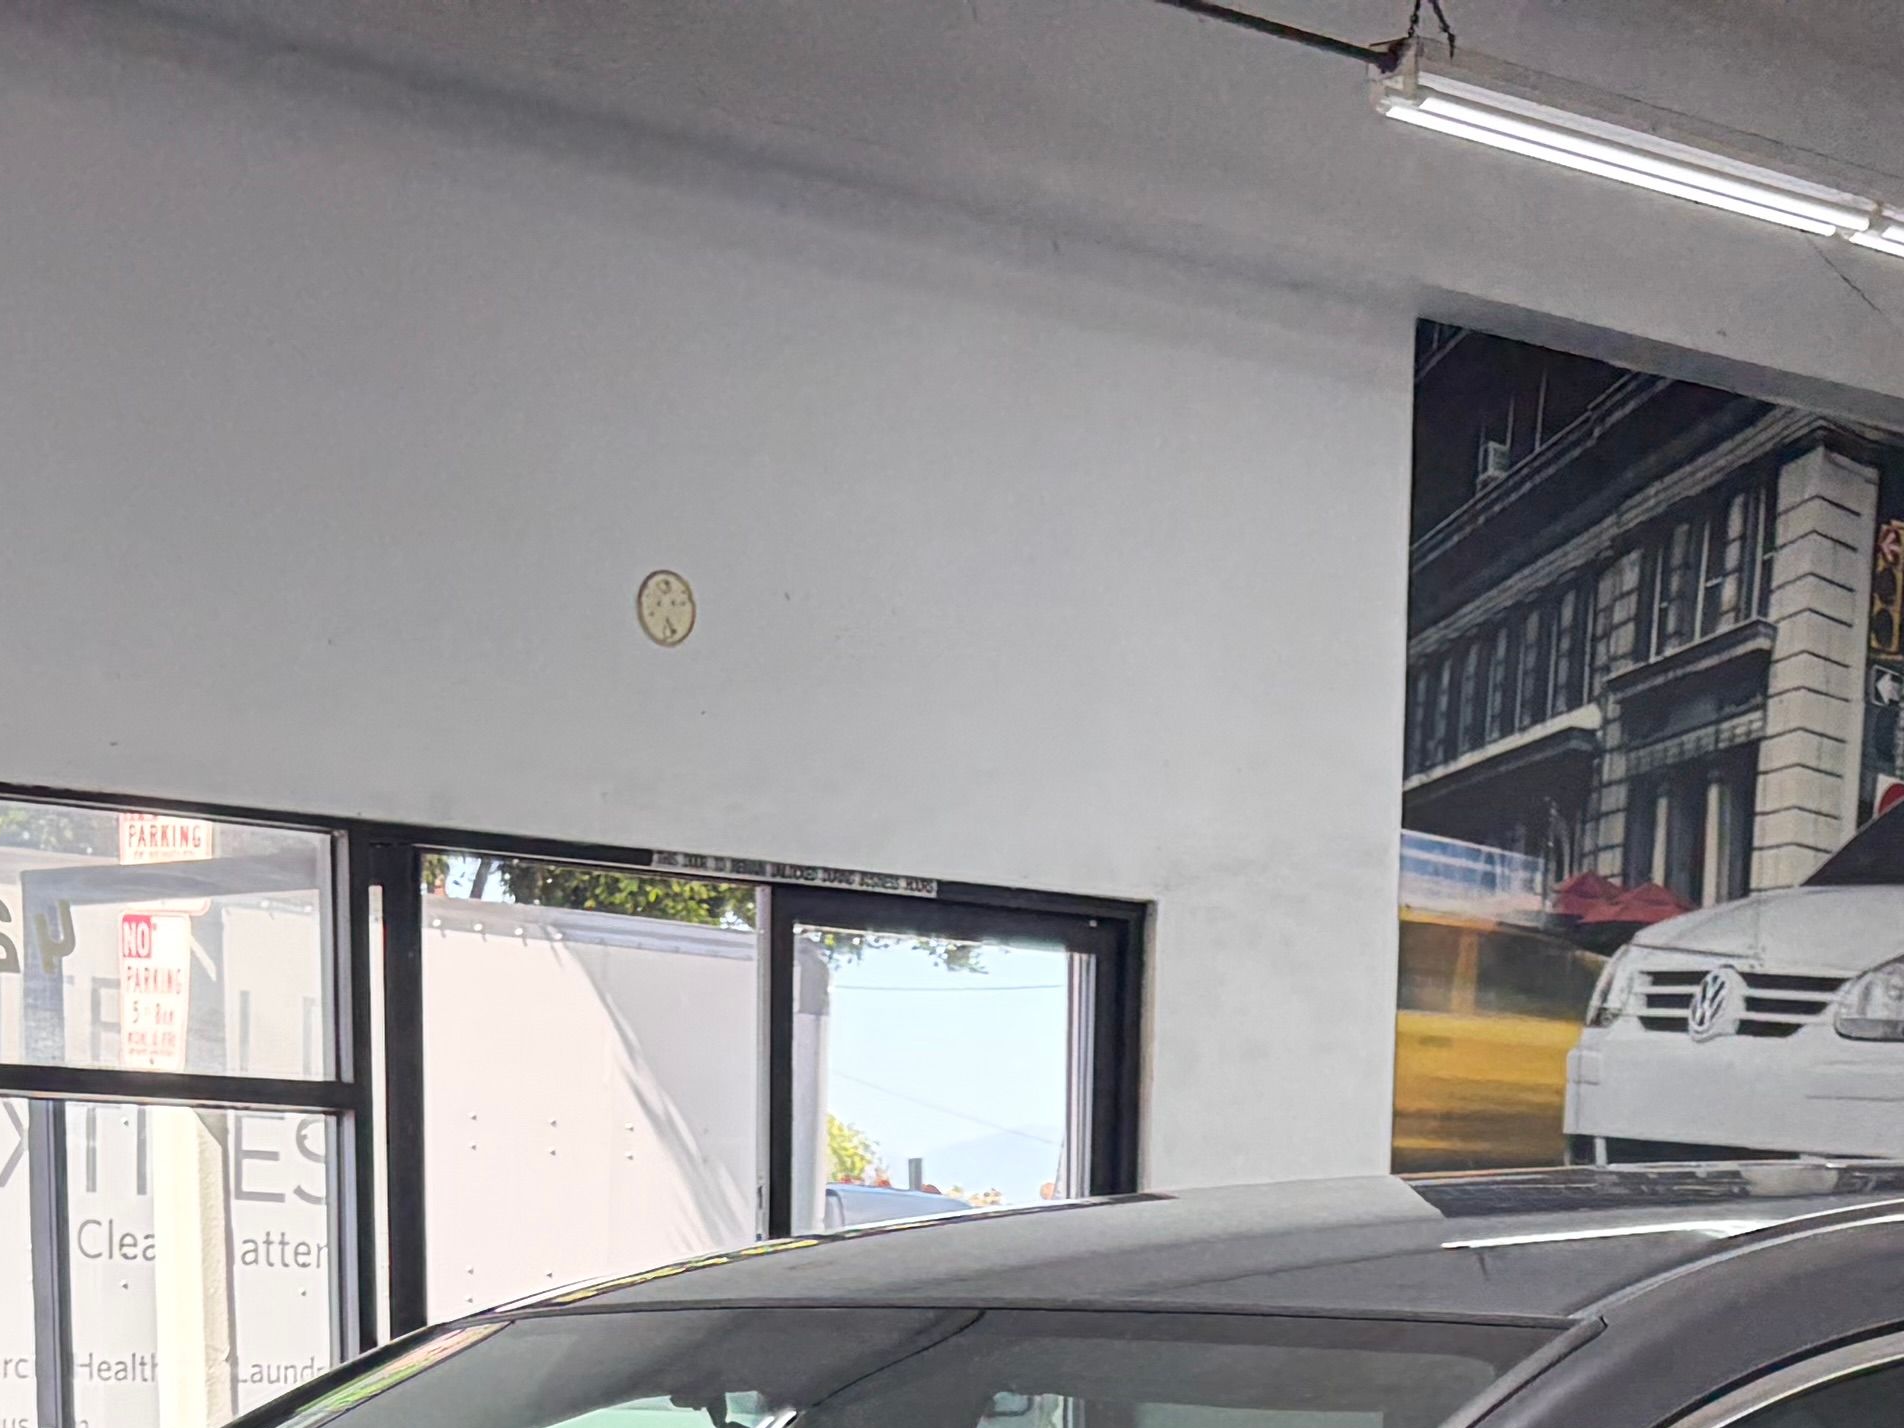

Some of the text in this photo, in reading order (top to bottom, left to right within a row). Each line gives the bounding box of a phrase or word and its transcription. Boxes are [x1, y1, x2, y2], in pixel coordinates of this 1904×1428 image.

[128, 824, 201, 848] PARKING
[123, 921, 152, 958] NO
[127, 966, 182, 994] PARKING
[77, 1219, 327, 1269] Clea atter
[78, 1352, 158, 1383] Health
